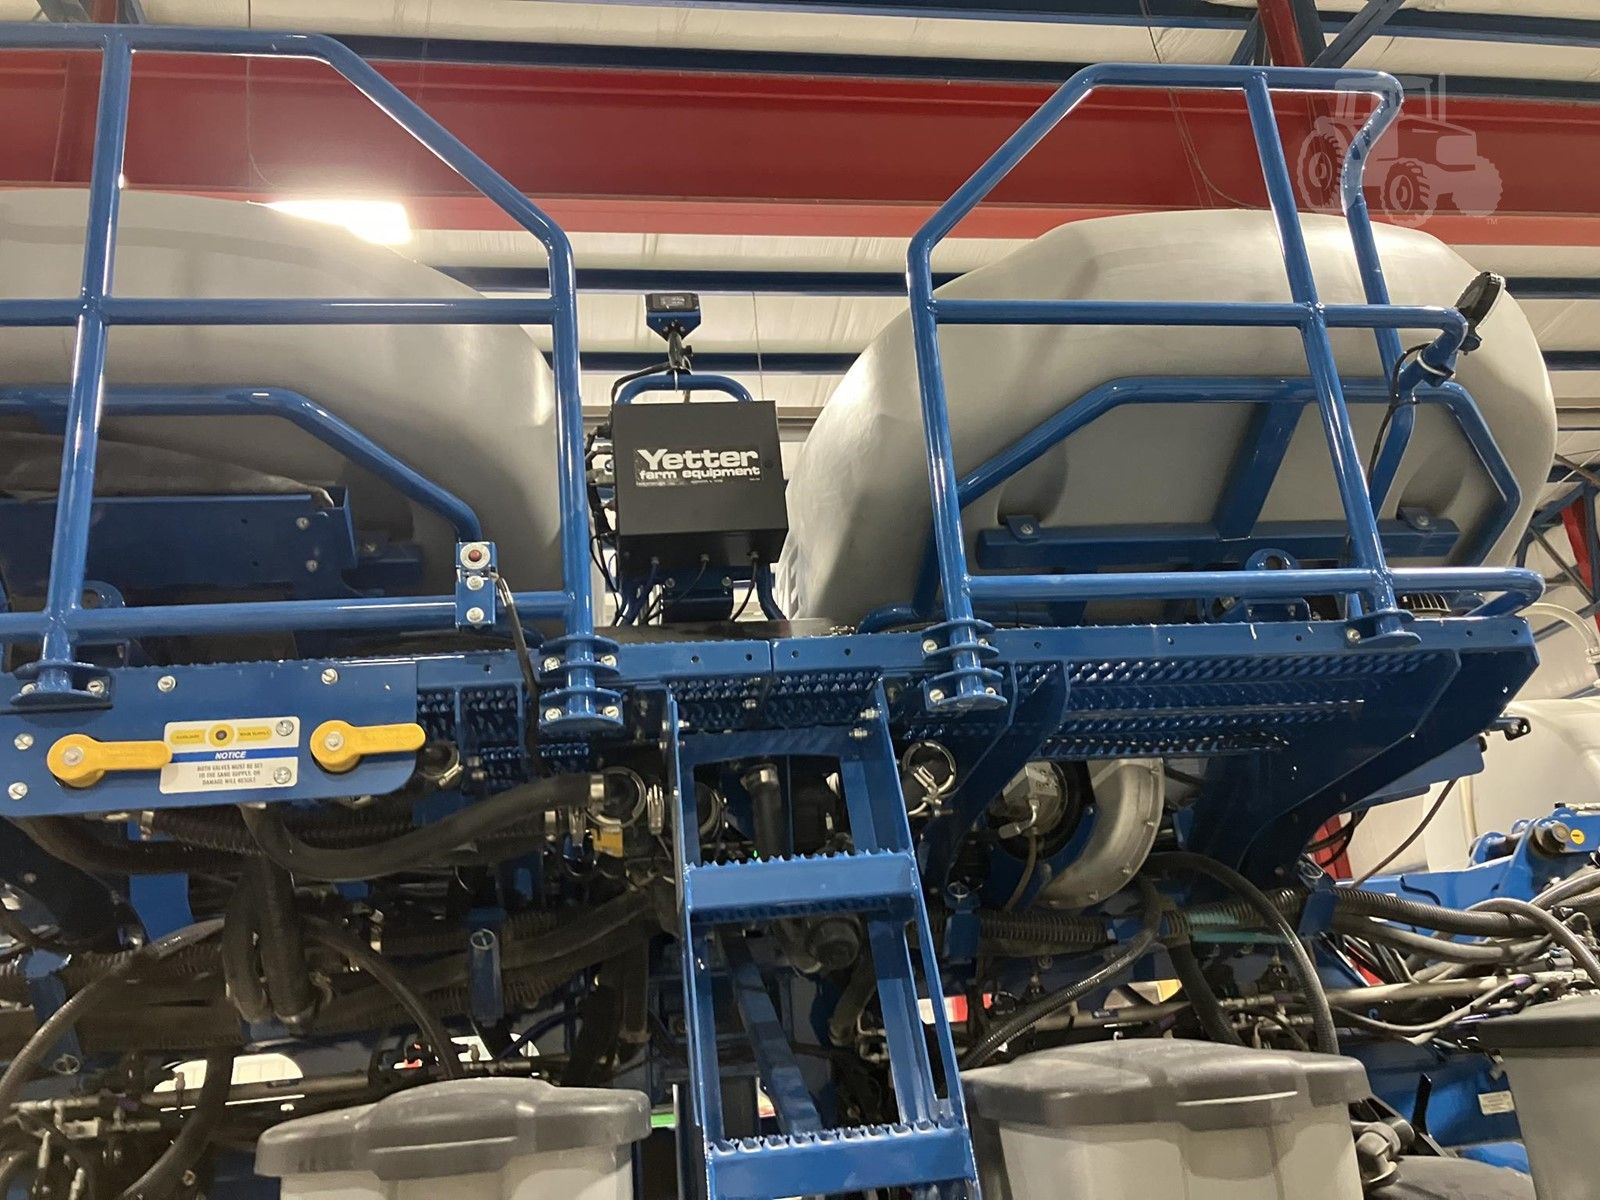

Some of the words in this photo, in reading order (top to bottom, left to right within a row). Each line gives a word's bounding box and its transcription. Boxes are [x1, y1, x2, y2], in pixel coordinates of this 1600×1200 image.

[637, 449, 759, 470] Yetter
[640, 470, 677, 480] farm
[682, 466, 761, 479] equipment
[215, 751, 247, 760] NOTICE
